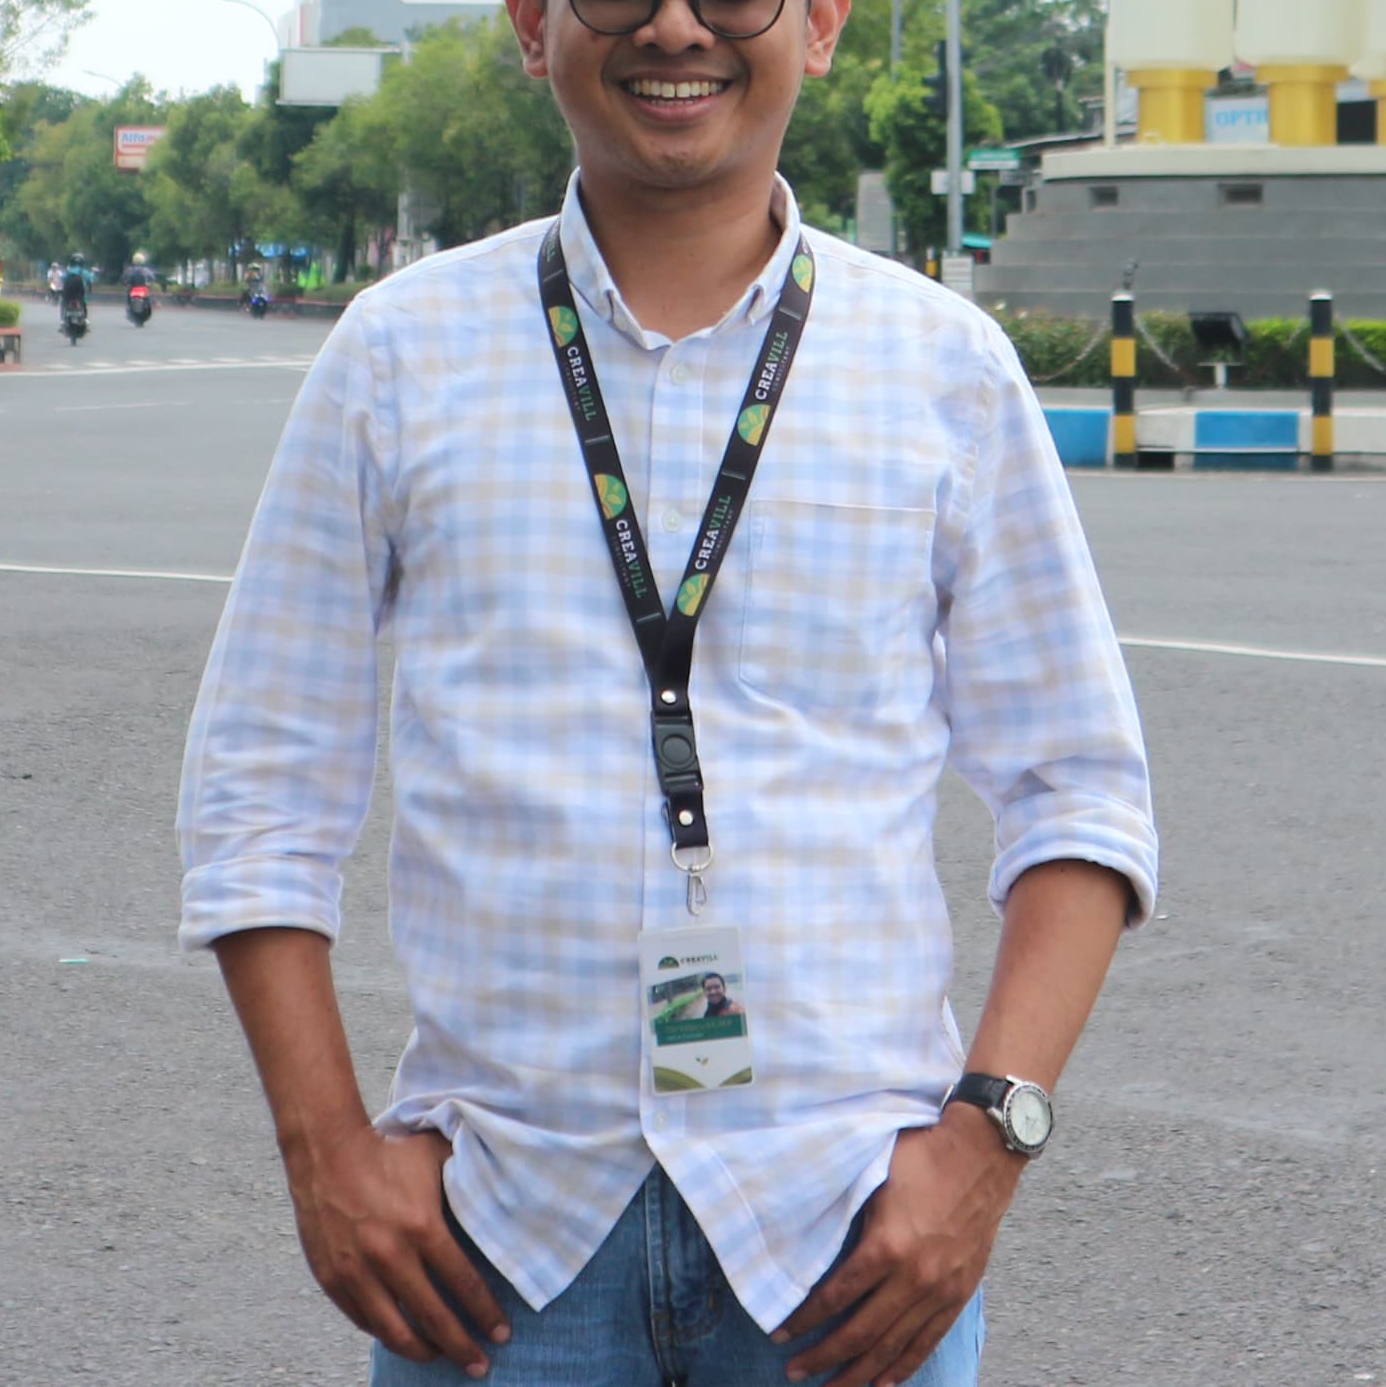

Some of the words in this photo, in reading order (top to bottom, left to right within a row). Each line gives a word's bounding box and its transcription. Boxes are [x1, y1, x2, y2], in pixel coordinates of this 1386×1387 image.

[566, 346, 597, 422] CREAVILL
[754, 331, 789, 400] CREAVILL
[615, 520, 645, 599] CREAVILL
[695, 495, 732, 571] CREAVILL
